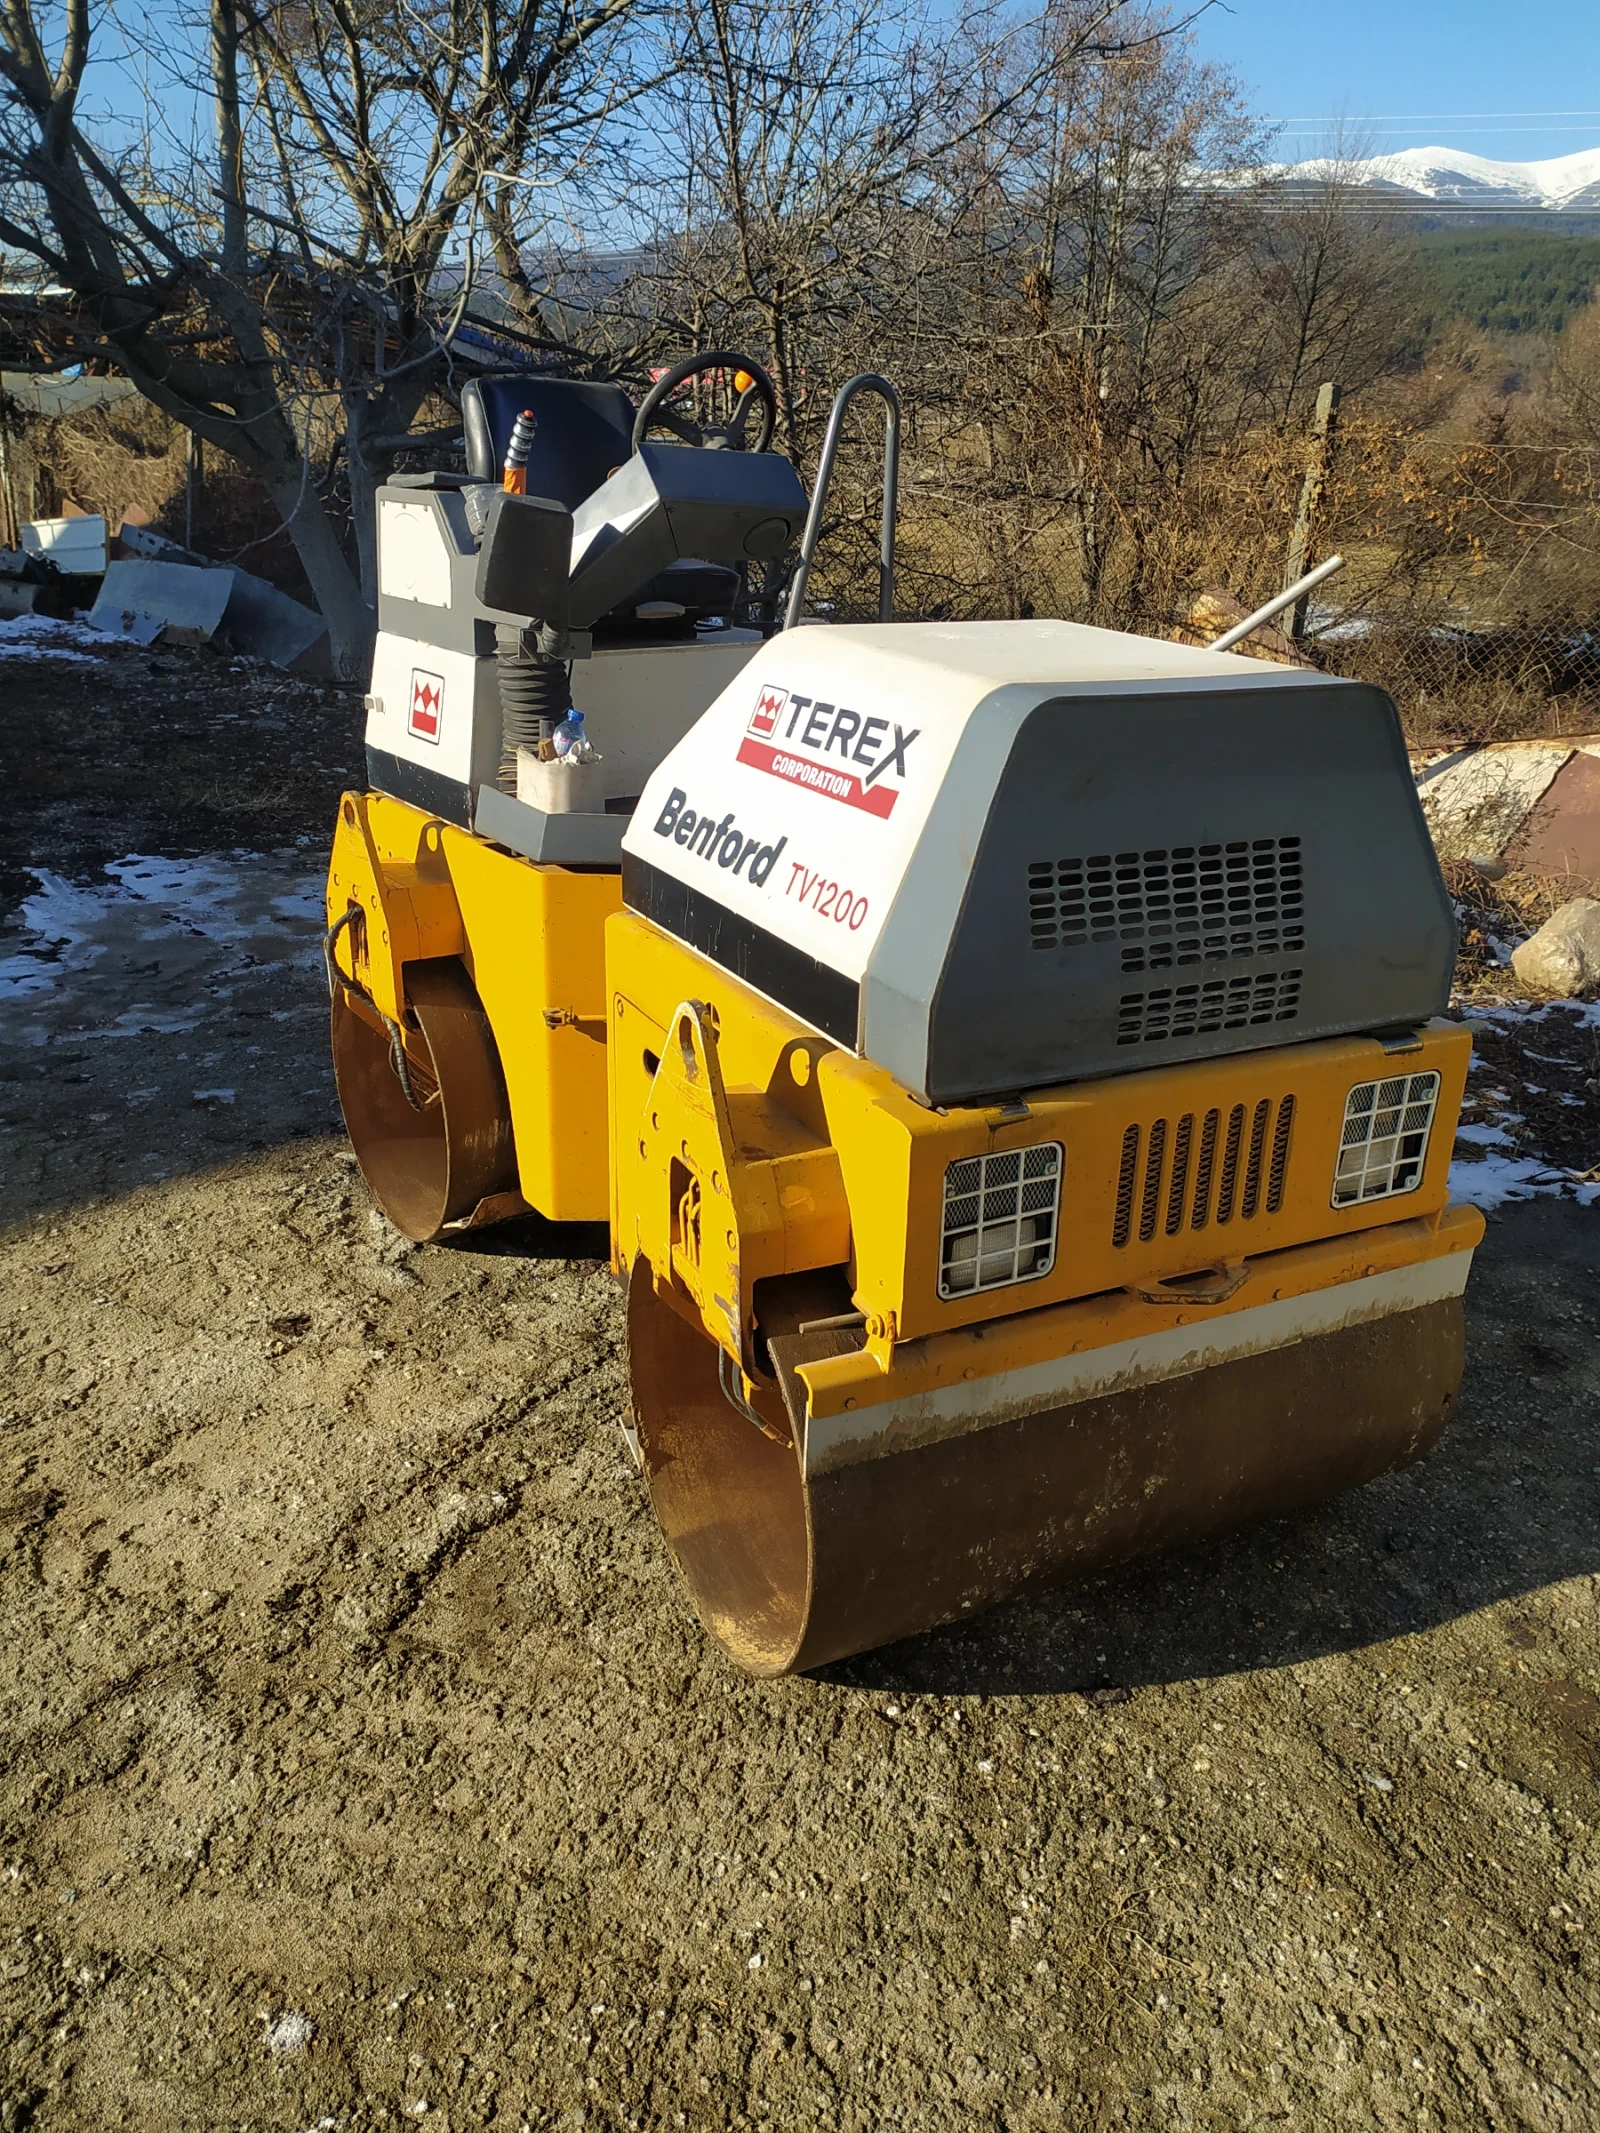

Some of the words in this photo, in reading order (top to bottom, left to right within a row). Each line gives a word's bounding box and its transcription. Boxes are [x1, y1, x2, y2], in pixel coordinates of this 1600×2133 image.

[771, 754, 853, 798] CORPORATION
[785, 694, 921, 786] TEREX
[653, 787, 788, 888] Benford
[785, 862, 868, 931] TV1200
